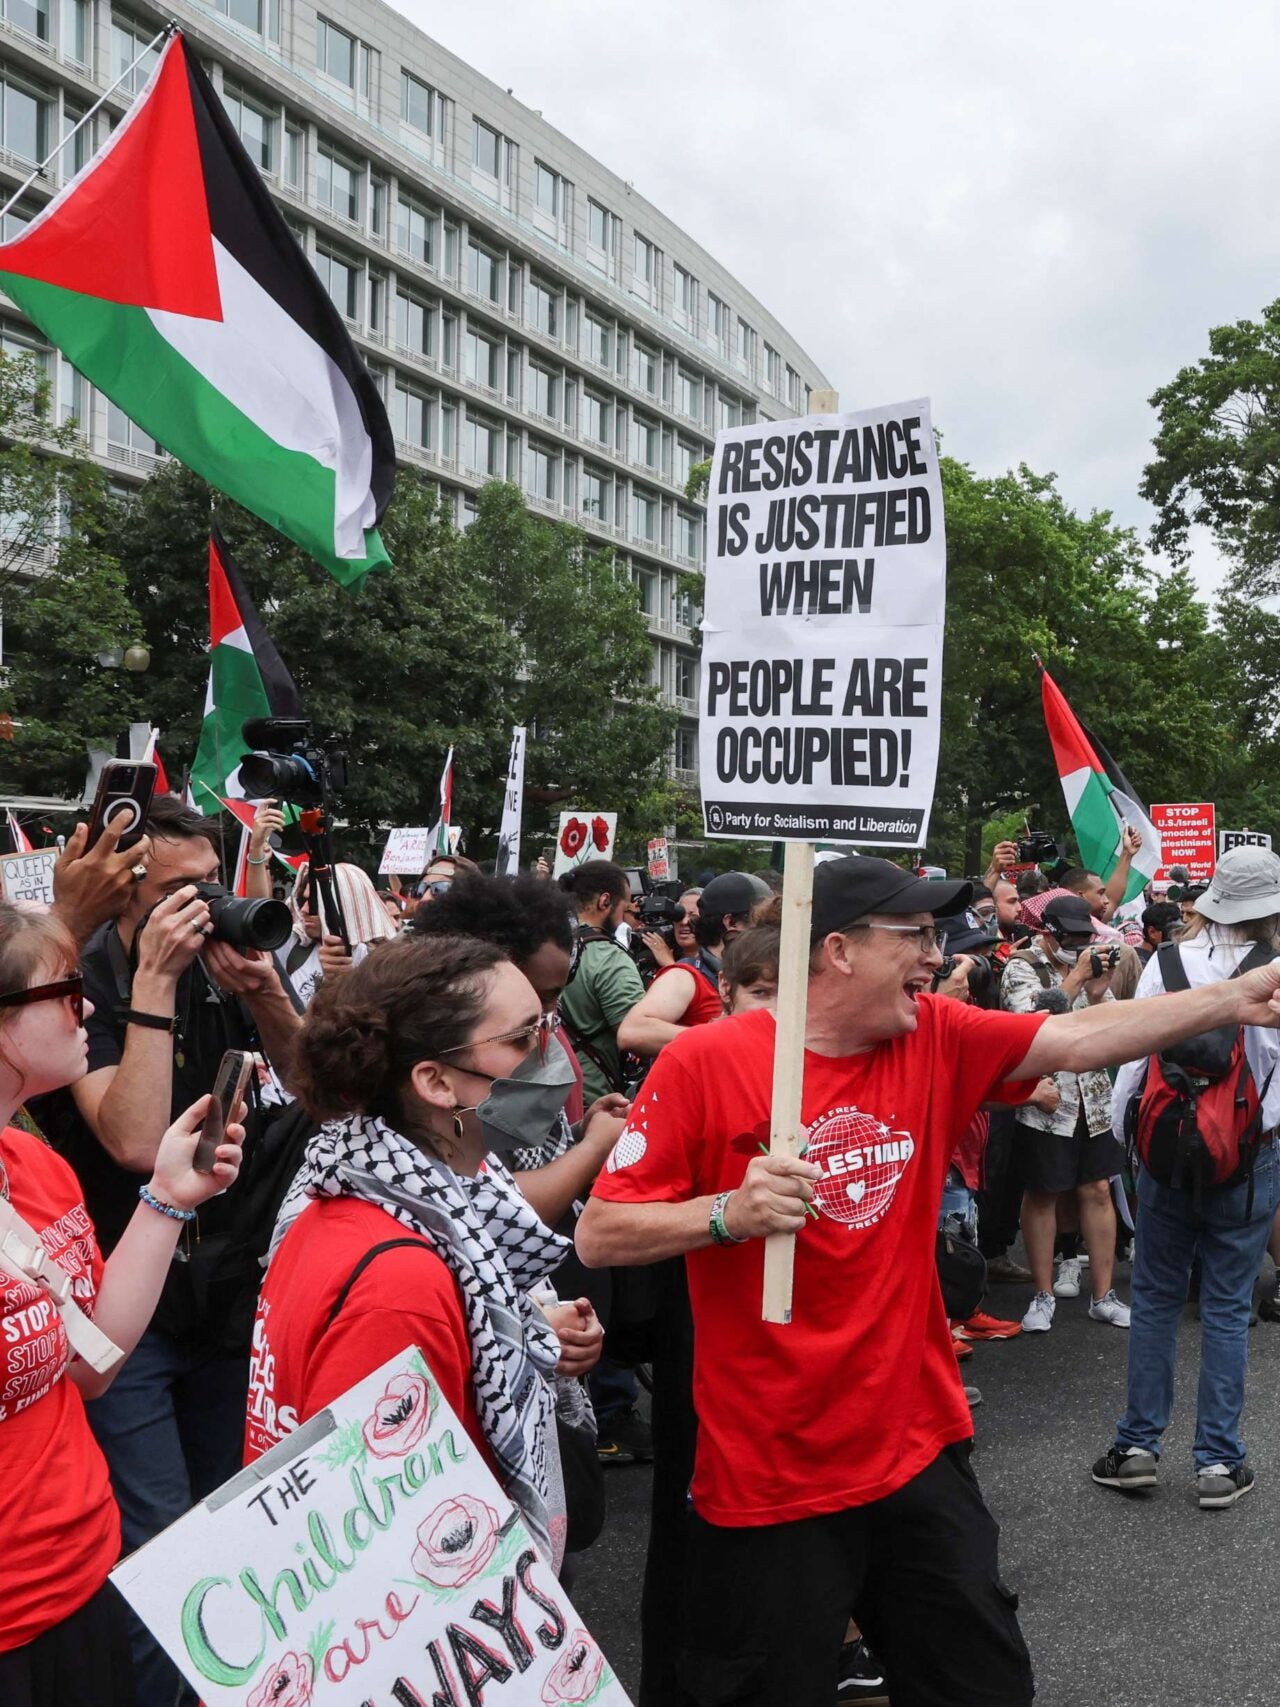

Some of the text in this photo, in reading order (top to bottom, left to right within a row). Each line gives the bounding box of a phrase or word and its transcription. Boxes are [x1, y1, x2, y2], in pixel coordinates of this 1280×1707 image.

[718, 416, 928, 494] RESISTANCE
[717, 486, 931, 557] IS JUSTIFIED
[759, 558, 875, 616] WHEN
[707, 658, 928, 717] PEOPLE ARE
[716, 726, 912, 788] OCCUPIED!
[725, 812, 752, 829] Party
[754, 813, 772, 827] for
[833, 816, 857, 831] and
[859, 817, 917, 834] Liberation
[1158, 819, 1208, 827] U.S./Israeli
[1166, 808, 1199, 817] STOP
[1202, 828, 1212, 837] of
[5, 855, 54, 879] QUEER
[1171, 849, 1196, 857] NOW!
[20, 876, 43, 888] AS IN
[828, 1105, 858, 1118] FREE
[848, 1215, 880, 1231] FREE
[2, 1300, 51, 1343] STOP
[8, 1329, 58, 1374] STOP
[247, 1457, 318, 1526] THE
[324, 1590, 419, 1682] are
